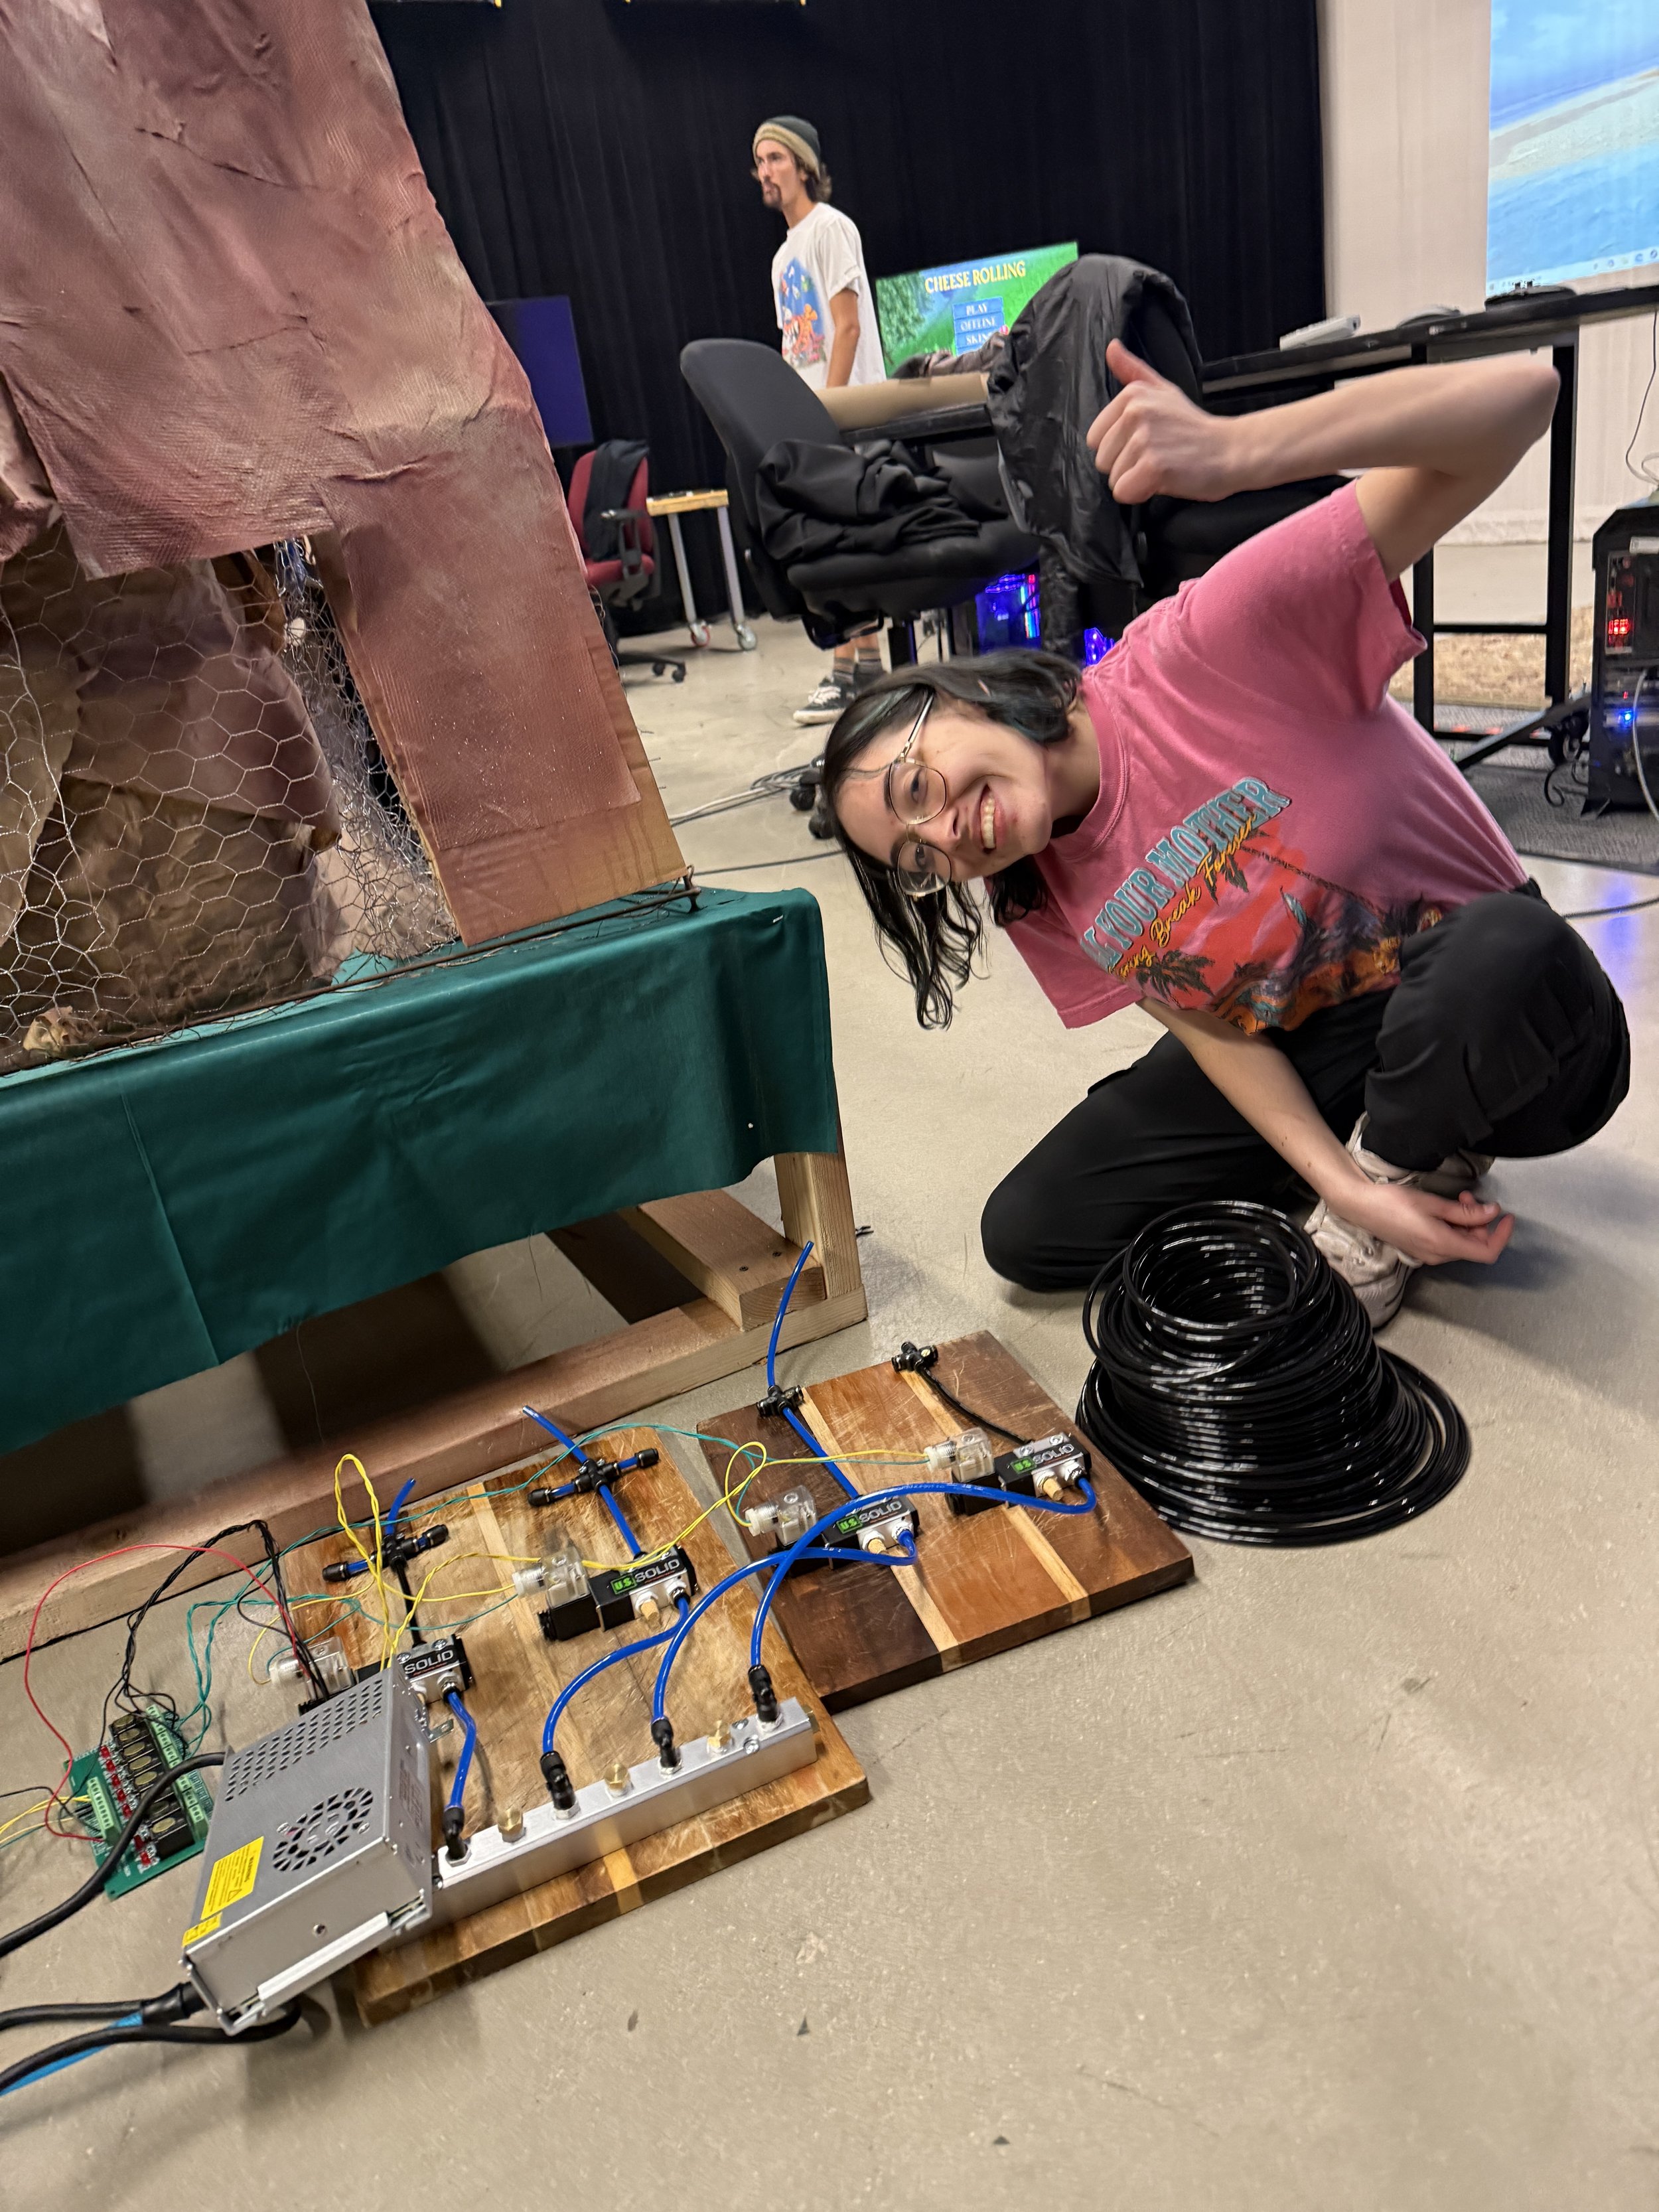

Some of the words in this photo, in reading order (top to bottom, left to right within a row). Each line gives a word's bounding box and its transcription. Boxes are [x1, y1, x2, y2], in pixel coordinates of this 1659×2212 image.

[924, 271, 970, 293] CHEESE
[973, 260, 1025, 286] ROLLING
[966, 303, 987, 316] PLAY
[1095, 867, 1175, 950] YOUR
[1145, 776, 1292, 888] MOTHER
[1149, 881, 1202, 948] Break
[1033, 1443, 1074, 1464] SOLID
[859, 1501, 902, 1523] SOLID
[634, 1560, 680, 1583] SOLID
[404, 1649, 454, 1674] SOLID
